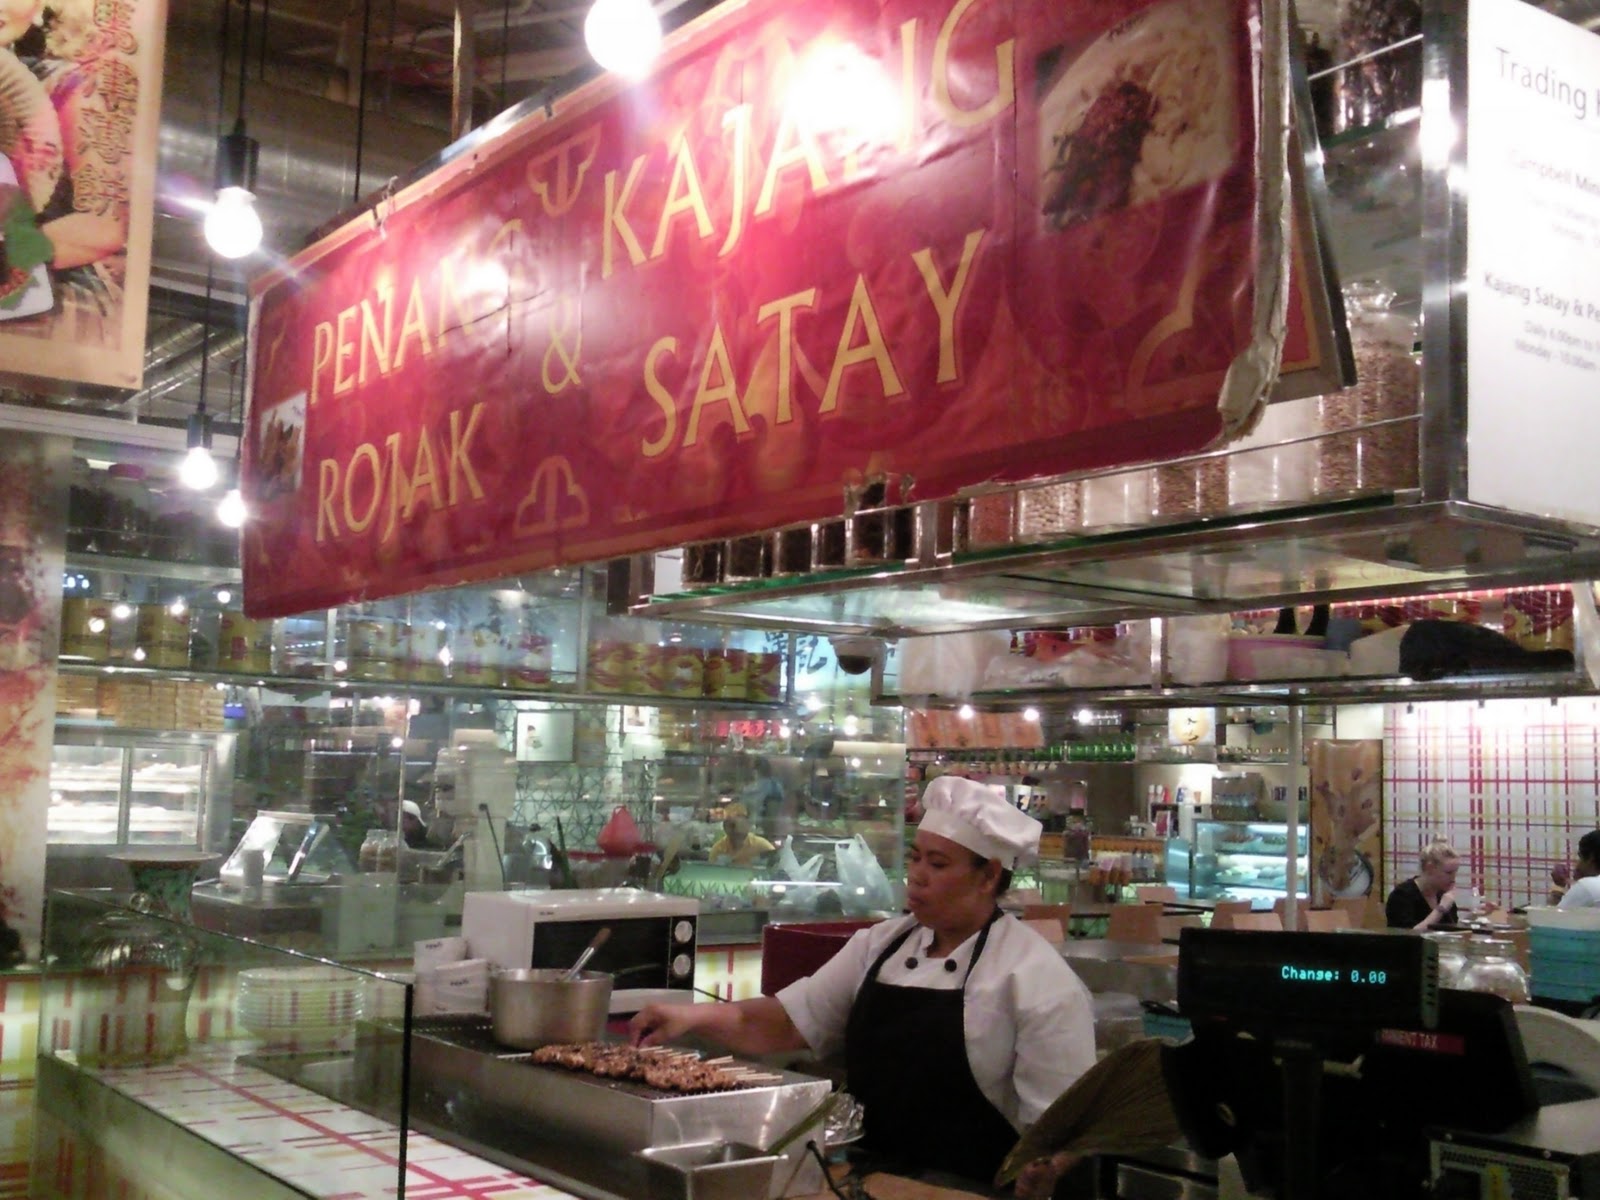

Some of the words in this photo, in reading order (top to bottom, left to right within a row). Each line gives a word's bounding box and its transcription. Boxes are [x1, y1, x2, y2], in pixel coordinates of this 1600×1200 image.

[1495, 46, 1588, 121] Trading
[310, 219, 525, 405] PENAN
[541, 293, 583, 394] &
[641, 229, 986, 458] SATAY
[1484, 272, 1530, 306] Kajang
[1535, 286, 1570, 317] Satay
[315, 402, 487, 544] ROJAK
[1281, 965, 1339, 981] Change:
[1350, 969, 1386, 984] 0.00
